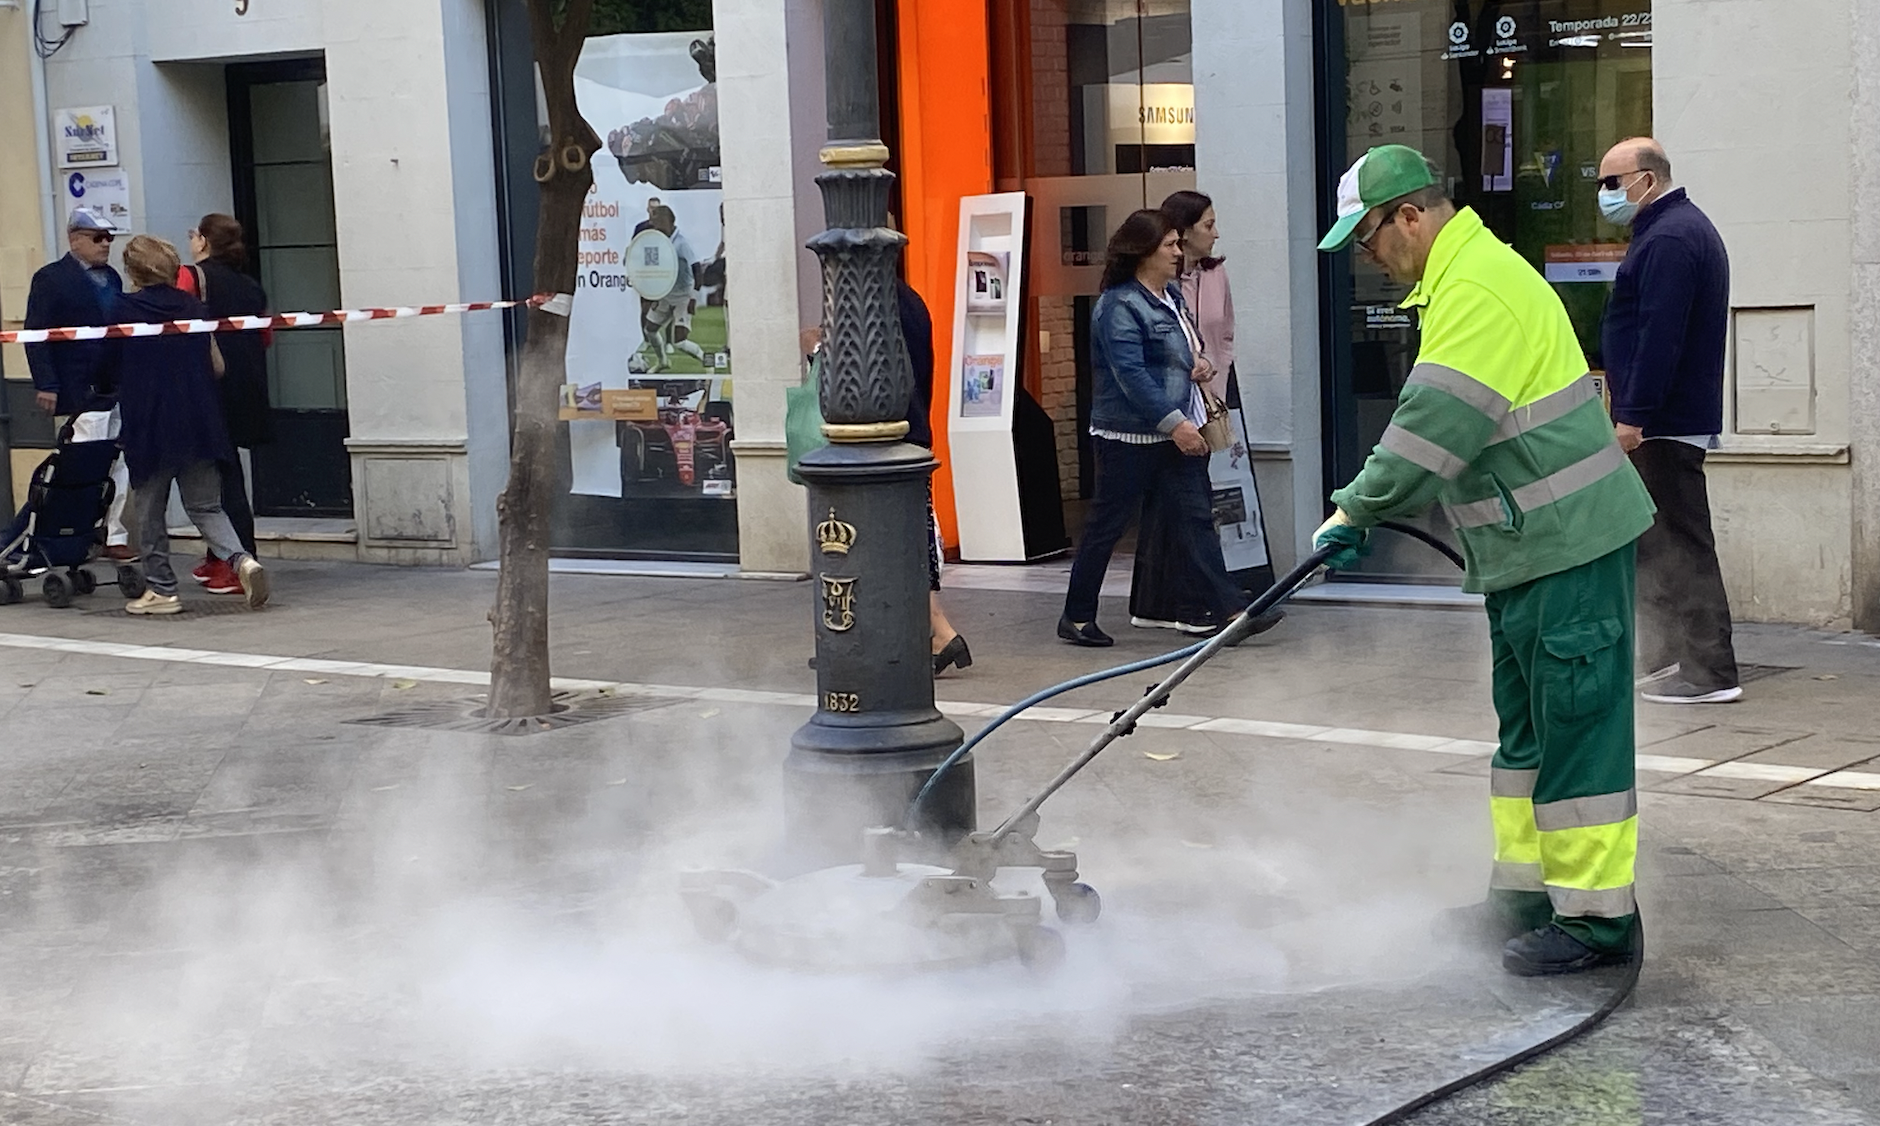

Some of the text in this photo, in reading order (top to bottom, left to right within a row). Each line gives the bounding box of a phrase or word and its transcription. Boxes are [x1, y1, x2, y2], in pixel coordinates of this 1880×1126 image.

[1548, 12, 1652, 33] Temporada 22/2
[1139, 106, 1194, 124] SAMSUN
[1581, 167, 1597, 177] VS
[580, 222, 607, 241] más
[578, 248, 619, 268] eporte
[1063, 251, 1105, 264] orange
[577, 270, 632, 292] n Orange
[824, 693, 860, 712] 1832
